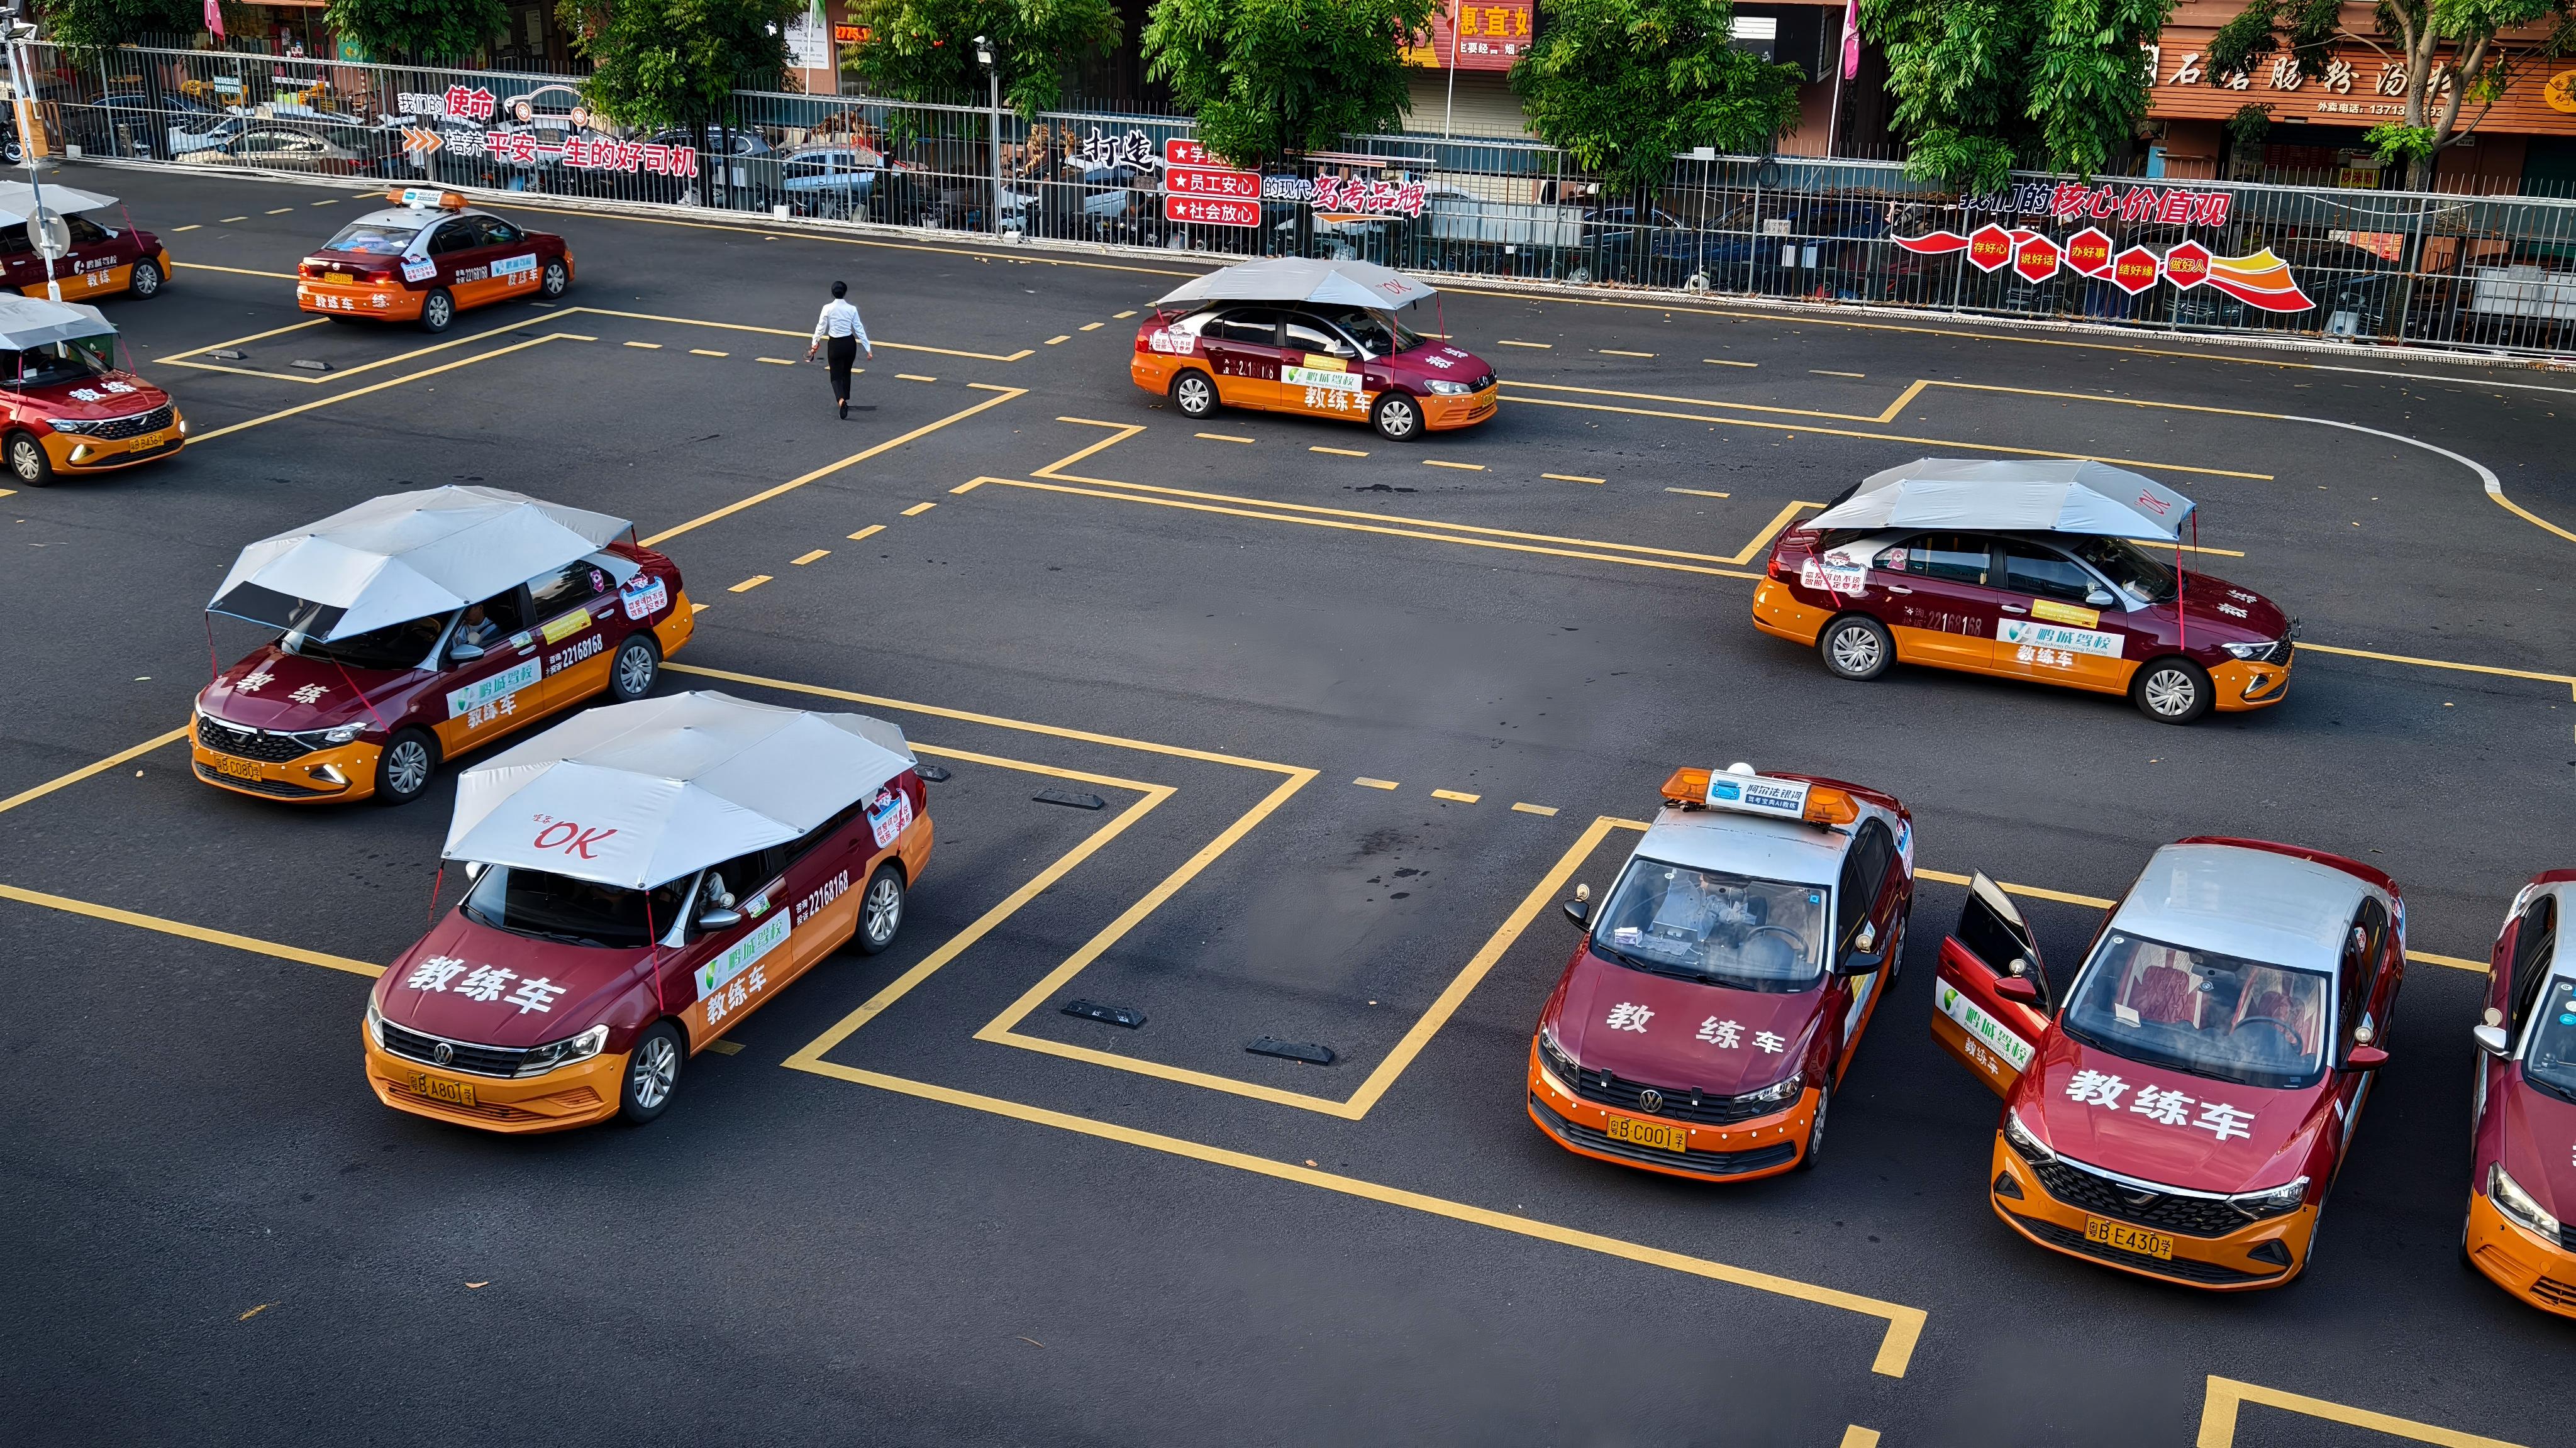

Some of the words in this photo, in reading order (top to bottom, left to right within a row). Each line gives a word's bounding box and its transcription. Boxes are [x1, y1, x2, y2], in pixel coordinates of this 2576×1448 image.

[445, 128, 698, 178] 培养平安一生的好司机
[1083, 126, 1158, 172] 打造
[1191, 173, 1253, 196] 员工安心
[1189, 201, 1253, 223] 社会放心
[1974, 241, 2007, 255] 存好心
[2021, 252, 2055, 266] 说好话
[2071, 247, 2106, 259] 办好事
[2118, 263, 2153, 277] 结好缘
[2169, 257, 2206, 274] 做好人
[1304, 385, 1372, 413] 教练车
[1926, 610, 1982, 636] 22168168
[562, 633, 603, 668] 22168168
[2036, 627, 2112, 649] 鹏城驾校
[2016, 644, 2073, 666] 教练车
[1746, 784, 1803, 800] 阿尔法银河
[533, 821, 618, 859] OK
[809, 870, 849, 917] 22168168
[407, 956, 567, 1014] 教练车
[707, 964, 767, 1025] 教练车
[1606, 1002, 1785, 1054] 教练车
[1965, 1006, 2028, 1064] 鹏城驾校
[1987, 1041, 2004, 1057] Driving
[2065, 1069, 2255, 1141] 教练车
